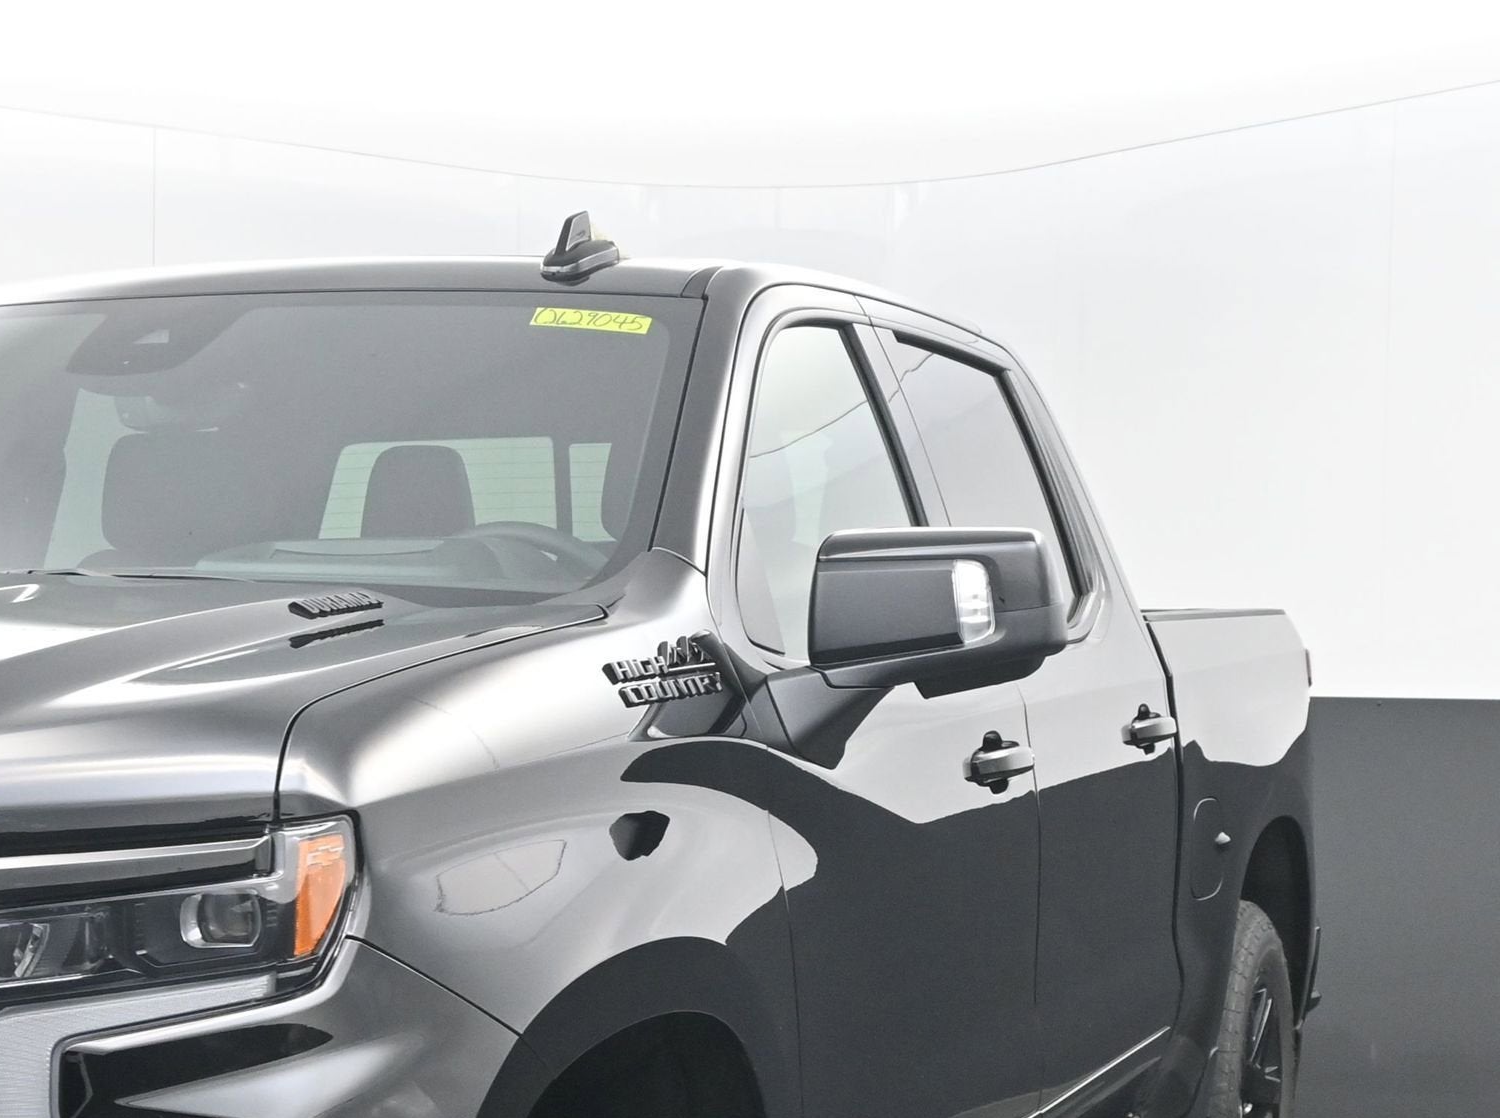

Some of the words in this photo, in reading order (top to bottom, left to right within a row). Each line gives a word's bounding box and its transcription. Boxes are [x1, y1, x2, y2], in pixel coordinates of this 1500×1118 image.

[289, 591, 384, 619] DURAMAX
[602, 656, 670, 685] HIGH
[619, 672, 722, 707] COUNTRY
